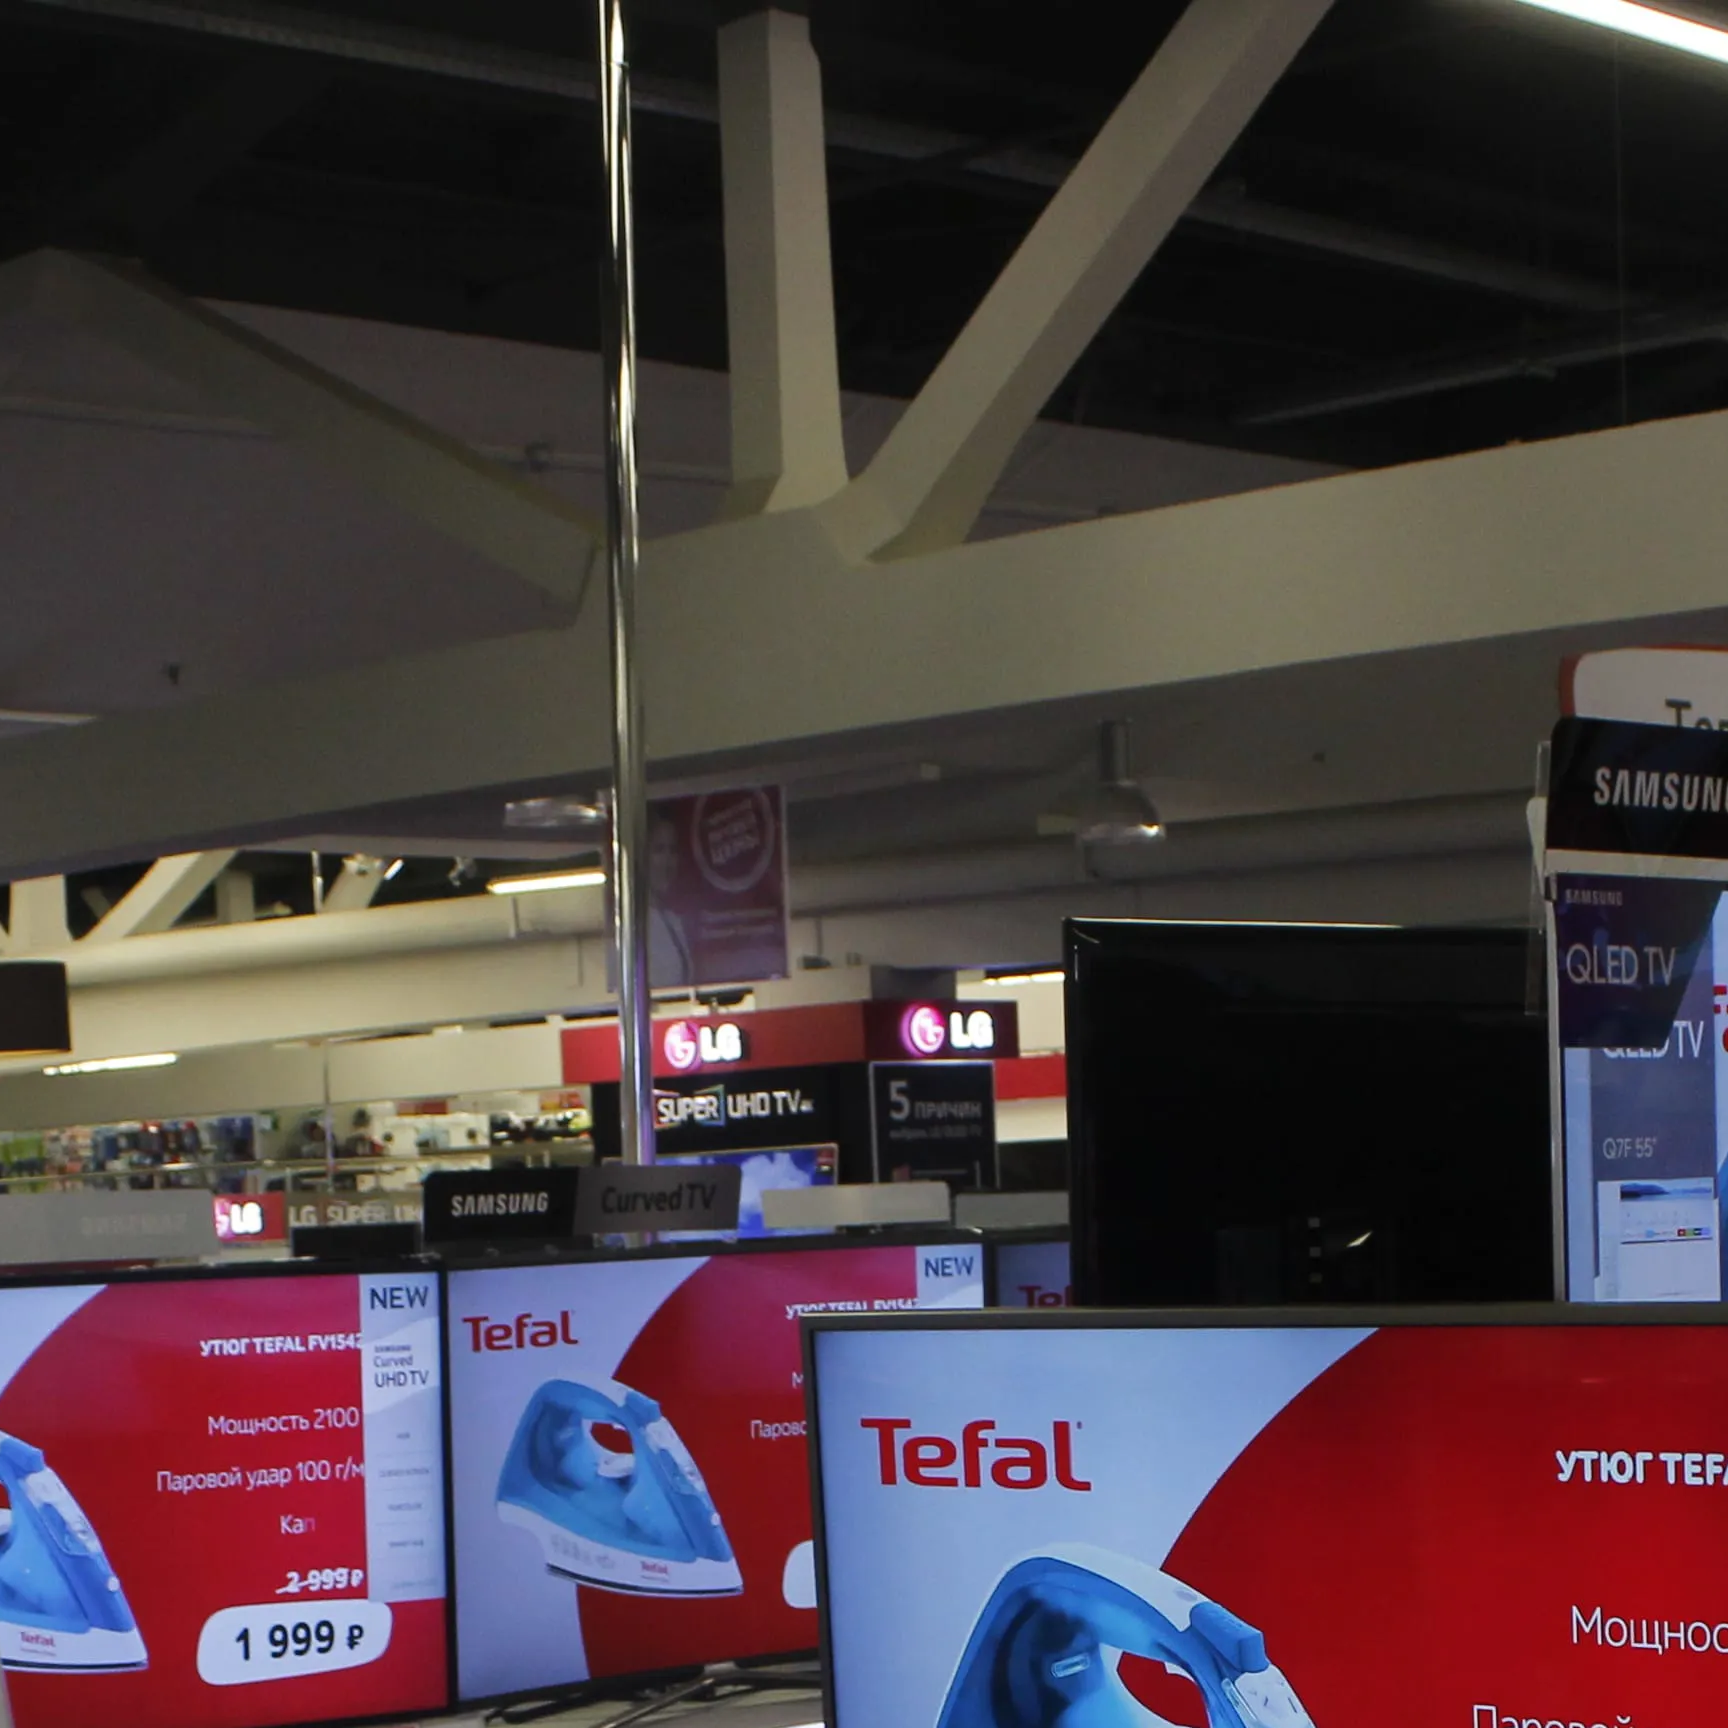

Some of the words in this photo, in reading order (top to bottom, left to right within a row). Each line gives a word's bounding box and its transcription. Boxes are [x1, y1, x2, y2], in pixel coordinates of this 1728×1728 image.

[1565, 888, 1623, 906] SAMSUNG
[1565, 943, 1639, 985] QLED
[1644, 945, 1677, 986] TV
[699, 1021, 744, 1064] LG
[948, 1009, 996, 1050] LG
[657, 1094, 719, 1125] SUPER
[726, 1092, 771, 1118] UHD
[888, 1079, 910, 1121] 5
[450, 1190, 550, 1219] SAMSUNG
[601, 1184, 683, 1214] Curved
[685, 1182, 718, 1211] TV
[923, 1256, 974, 1279] NEW
[369, 1286, 430, 1311] NEW
[199, 1336, 250, 1358] УТЮГ
[252, 1335, 306, 1356] TEFAL
[463, 1311, 580, 1353] Tefal
[373, 1354, 414, 1368] Curved
[374, 1370, 408, 1388] UHD
[409, 1369, 430, 1386] TV
[207, 1411, 310, 1437] Мощность
[313, 1406, 360, 1431] 2100
[861, 1417, 1092, 1493] Tefal
[1554, 1449, 1656, 1485] УТЮГ
[156, 1468, 241, 1494] Паровой
[245, 1465, 291, 1490] удар
[295, 1462, 331, 1486] 100
[267, 1619, 336, 1659] 999
